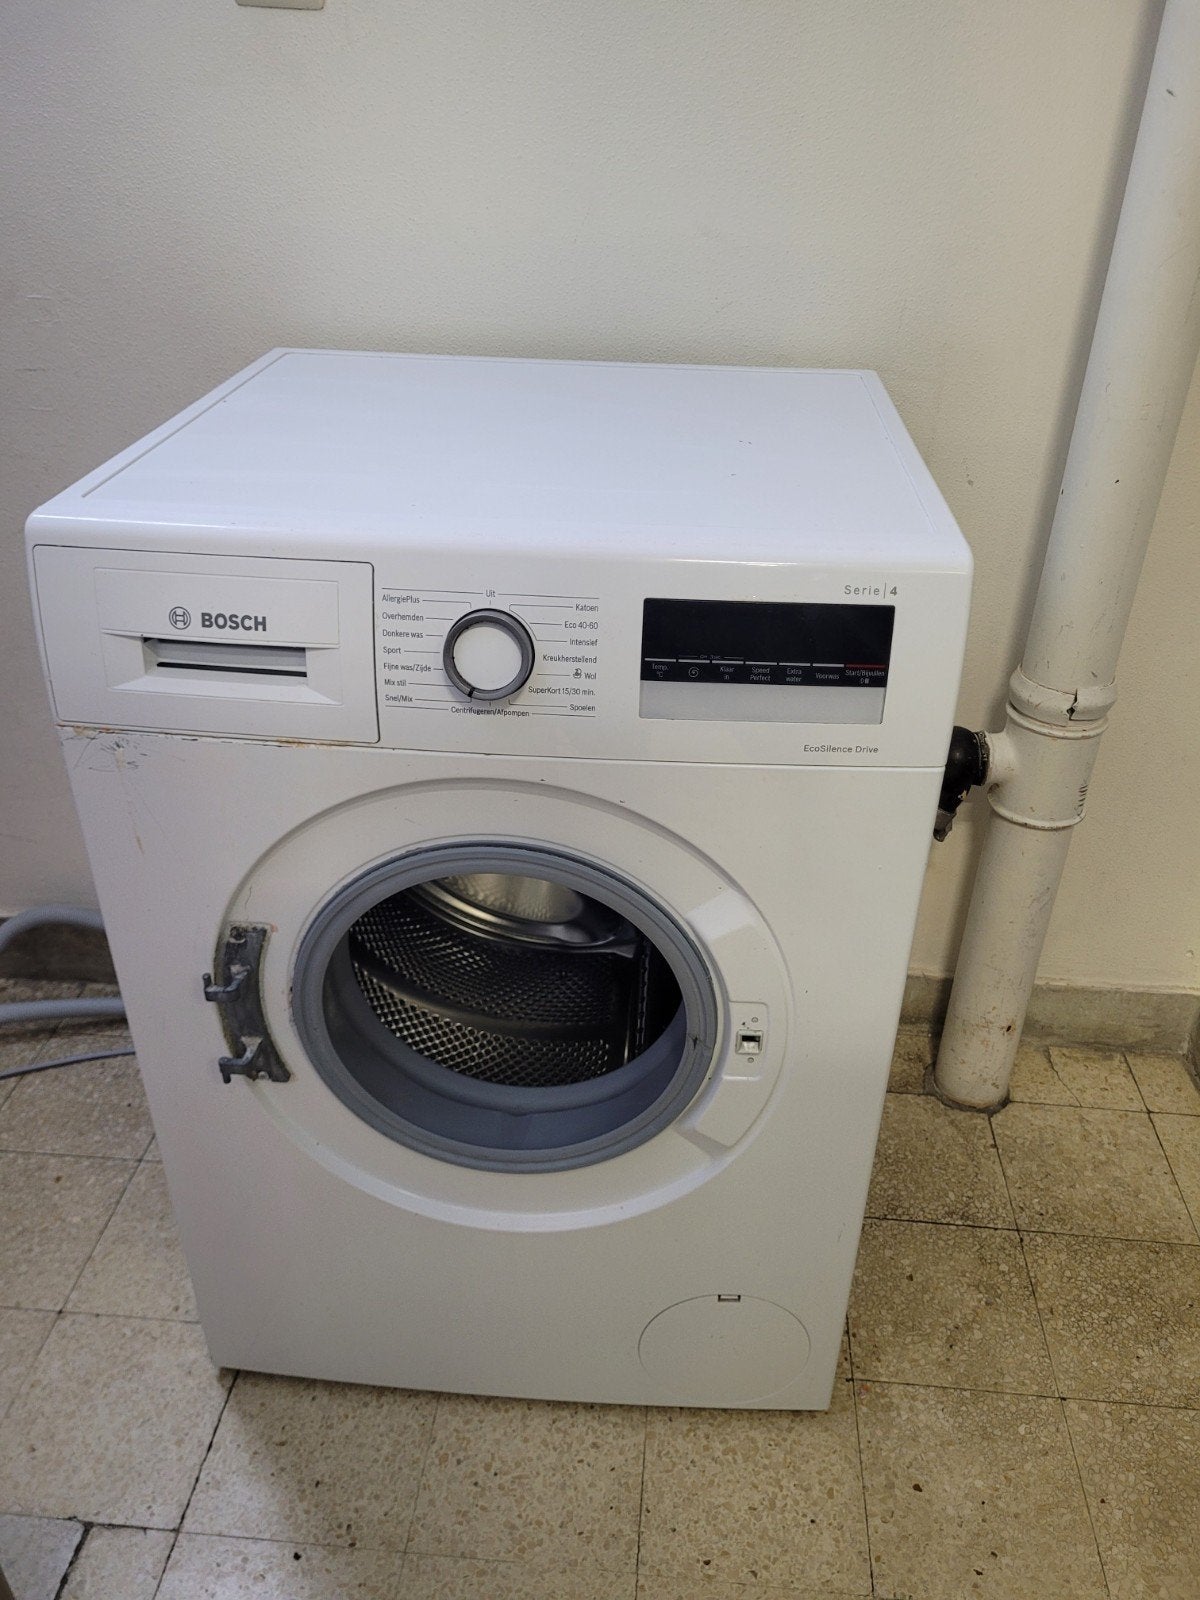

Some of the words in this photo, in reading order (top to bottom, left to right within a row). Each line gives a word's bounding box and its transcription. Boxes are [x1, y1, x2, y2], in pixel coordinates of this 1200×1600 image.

[485, 589, 496, 598] Uit
[844, 584, 880, 596] Serie
[889, 586, 898, 596] 4
[381, 594, 421, 604] AllergiePlus
[575, 603, 599, 612] Katoen
[381, 612, 424, 621] Overhemden
[201, 612, 267, 632] BOSCH
[564, 620, 577, 629] Eco
[578, 621, 599, 630] 40-60
[382, 629, 410, 638] Donkere
[569, 638, 598, 647] Intensief
[383, 646, 402, 655] Sport
[542, 654, 598, 664] Kreukherstellend
[383, 662, 399, 671] Fijne
[400, 664, 432, 673] was/Zijde
[751, 666, 770, 675] Speed
[786, 667, 802, 675] Extra
[749, 674, 771, 682] Perfect
[815, 672, 840, 680] Voorwas
[384, 678, 396, 686] Mix
[396, 679, 407, 687] stil
[528, 686, 561, 695] SuperKort
[562, 688, 581, 696] 15/30
[384, 695, 413, 703] Snel/Mix
[450, 706, 530, 717] Centrifugeren/Afpompen
[569, 703, 596, 713] Spoelen
[803, 744, 853, 753] EcoSilence
[855, 745, 879, 754] Drive
